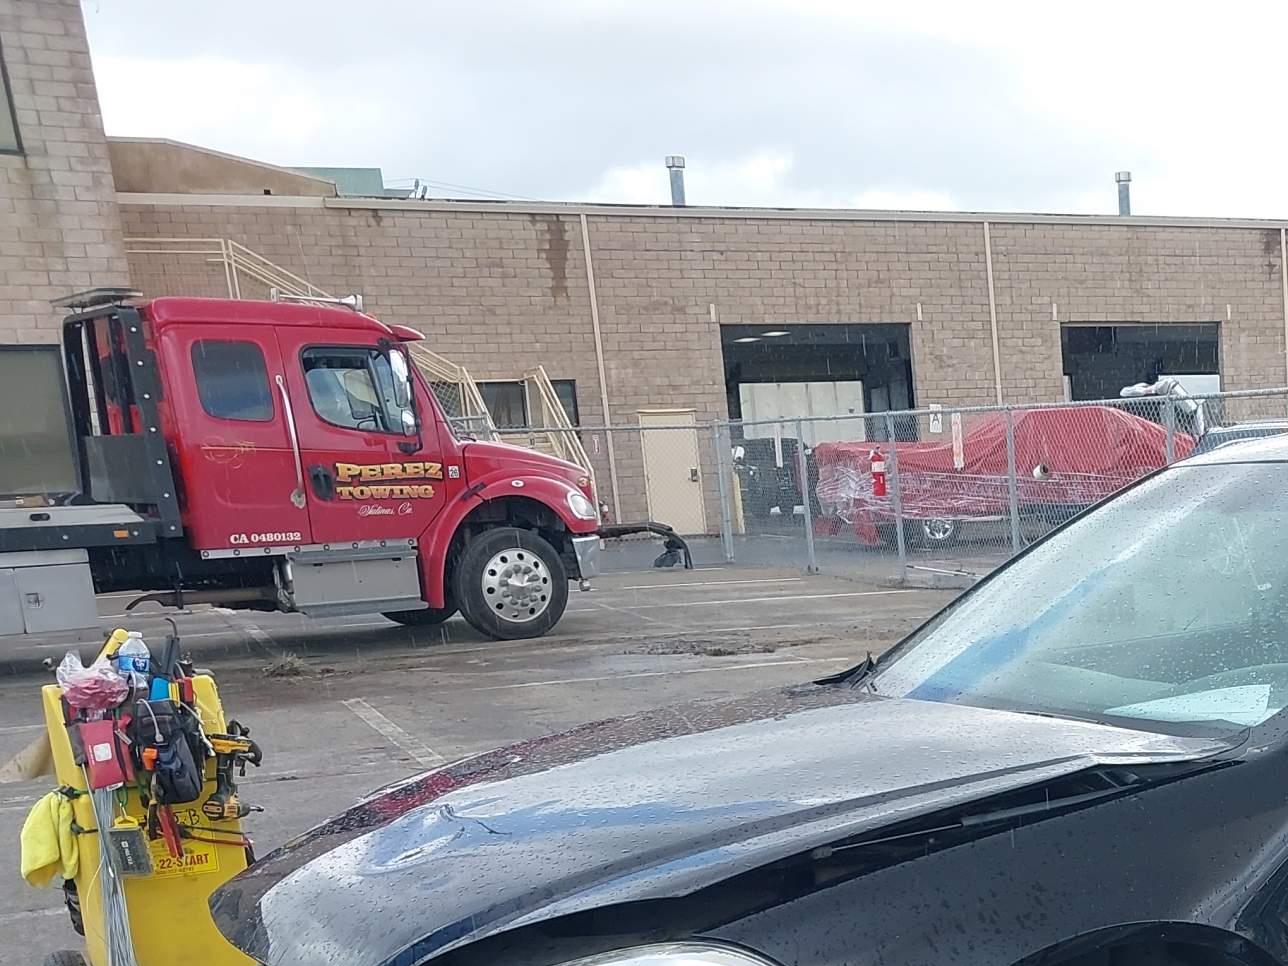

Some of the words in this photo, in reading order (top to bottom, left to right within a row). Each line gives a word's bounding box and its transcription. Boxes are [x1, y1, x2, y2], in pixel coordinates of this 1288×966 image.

[335, 462, 443, 482] PEREZ
[336, 484, 435, 500] TOWING
[230, 536, 249, 544] CA
[251, 532, 301, 542] 0480132
